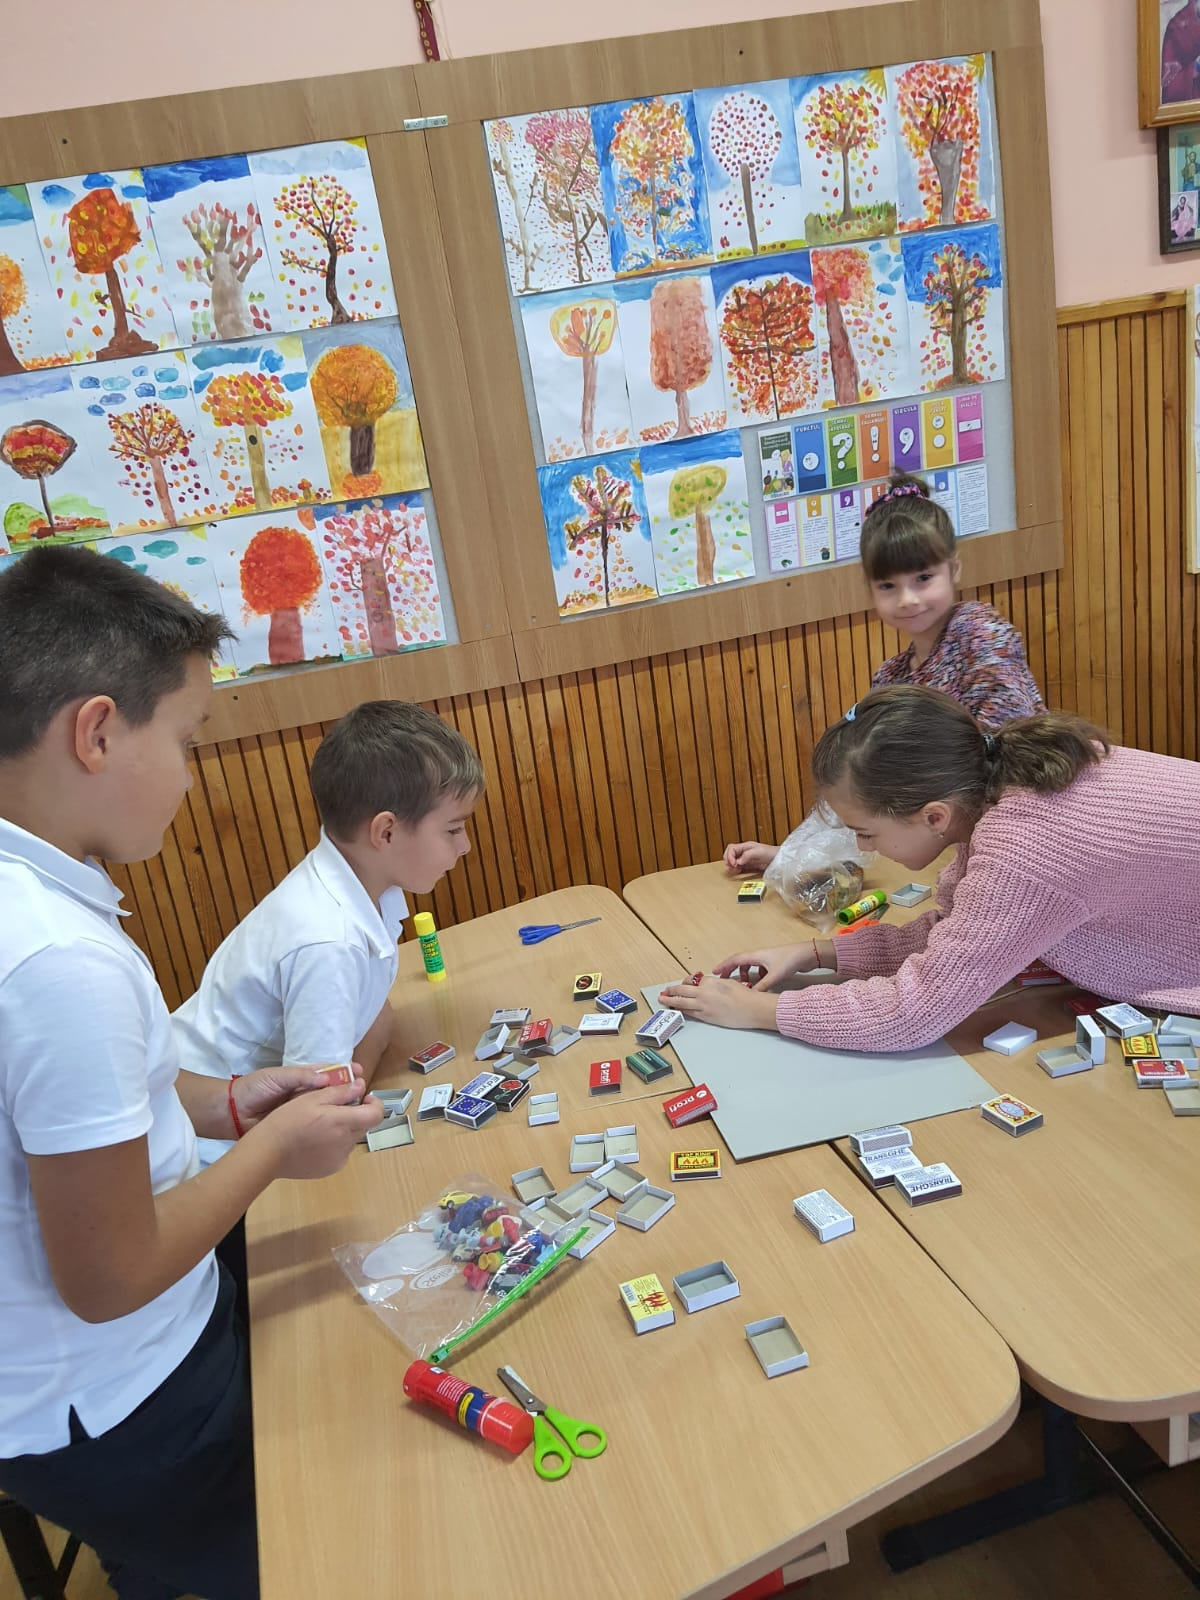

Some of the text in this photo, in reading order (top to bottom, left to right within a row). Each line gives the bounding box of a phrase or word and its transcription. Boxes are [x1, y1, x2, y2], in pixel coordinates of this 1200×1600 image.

[600, 1069, 611, 1084] profi
[669, 1095, 695, 1113] profi
[864, 1148, 905, 1162] TRANSGHE
[911, 1175, 954, 1193] TRANSGHE
